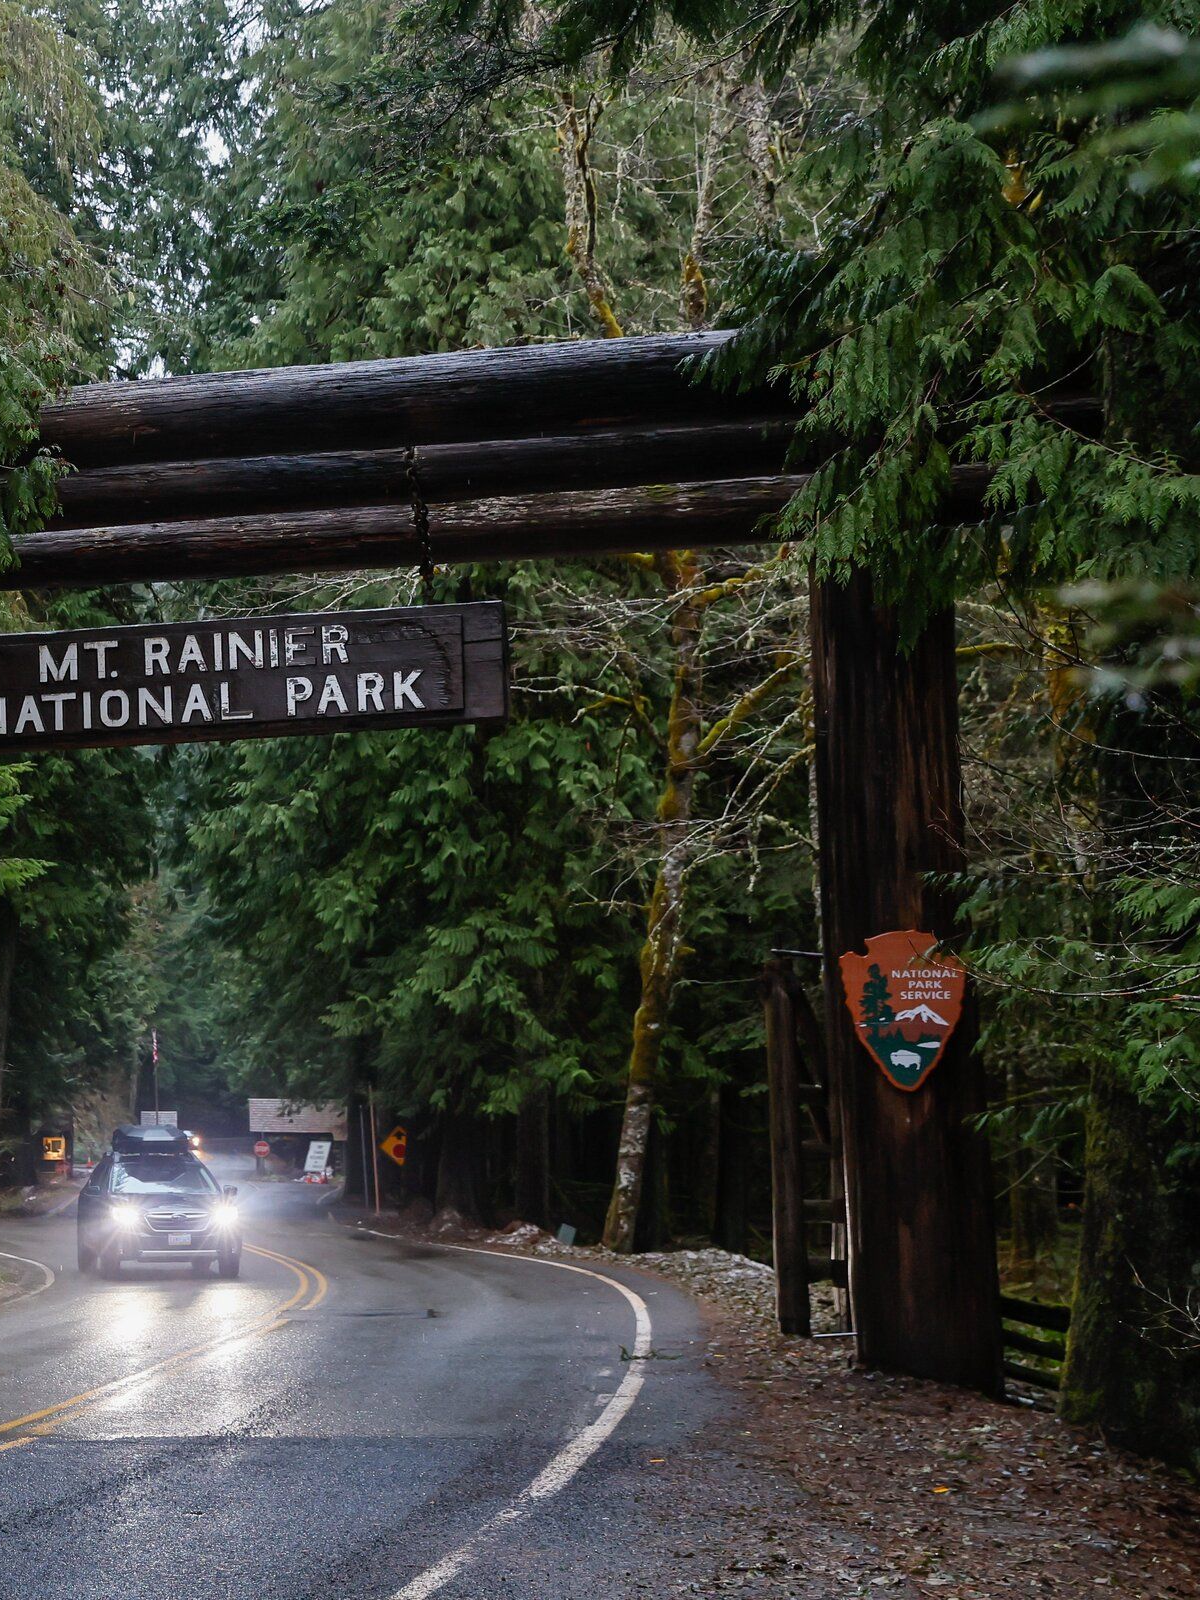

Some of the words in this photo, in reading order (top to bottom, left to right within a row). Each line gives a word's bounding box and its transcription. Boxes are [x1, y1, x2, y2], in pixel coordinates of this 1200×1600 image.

[38, 640, 119, 683] MT.
[144, 624, 350, 677] RAINIER
[286, 669, 426, 717] PARK
[891, 969, 958, 978] NATIONAL
[908, 980, 942, 989] PARK
[900, 990, 951, 1000] SERVICE
